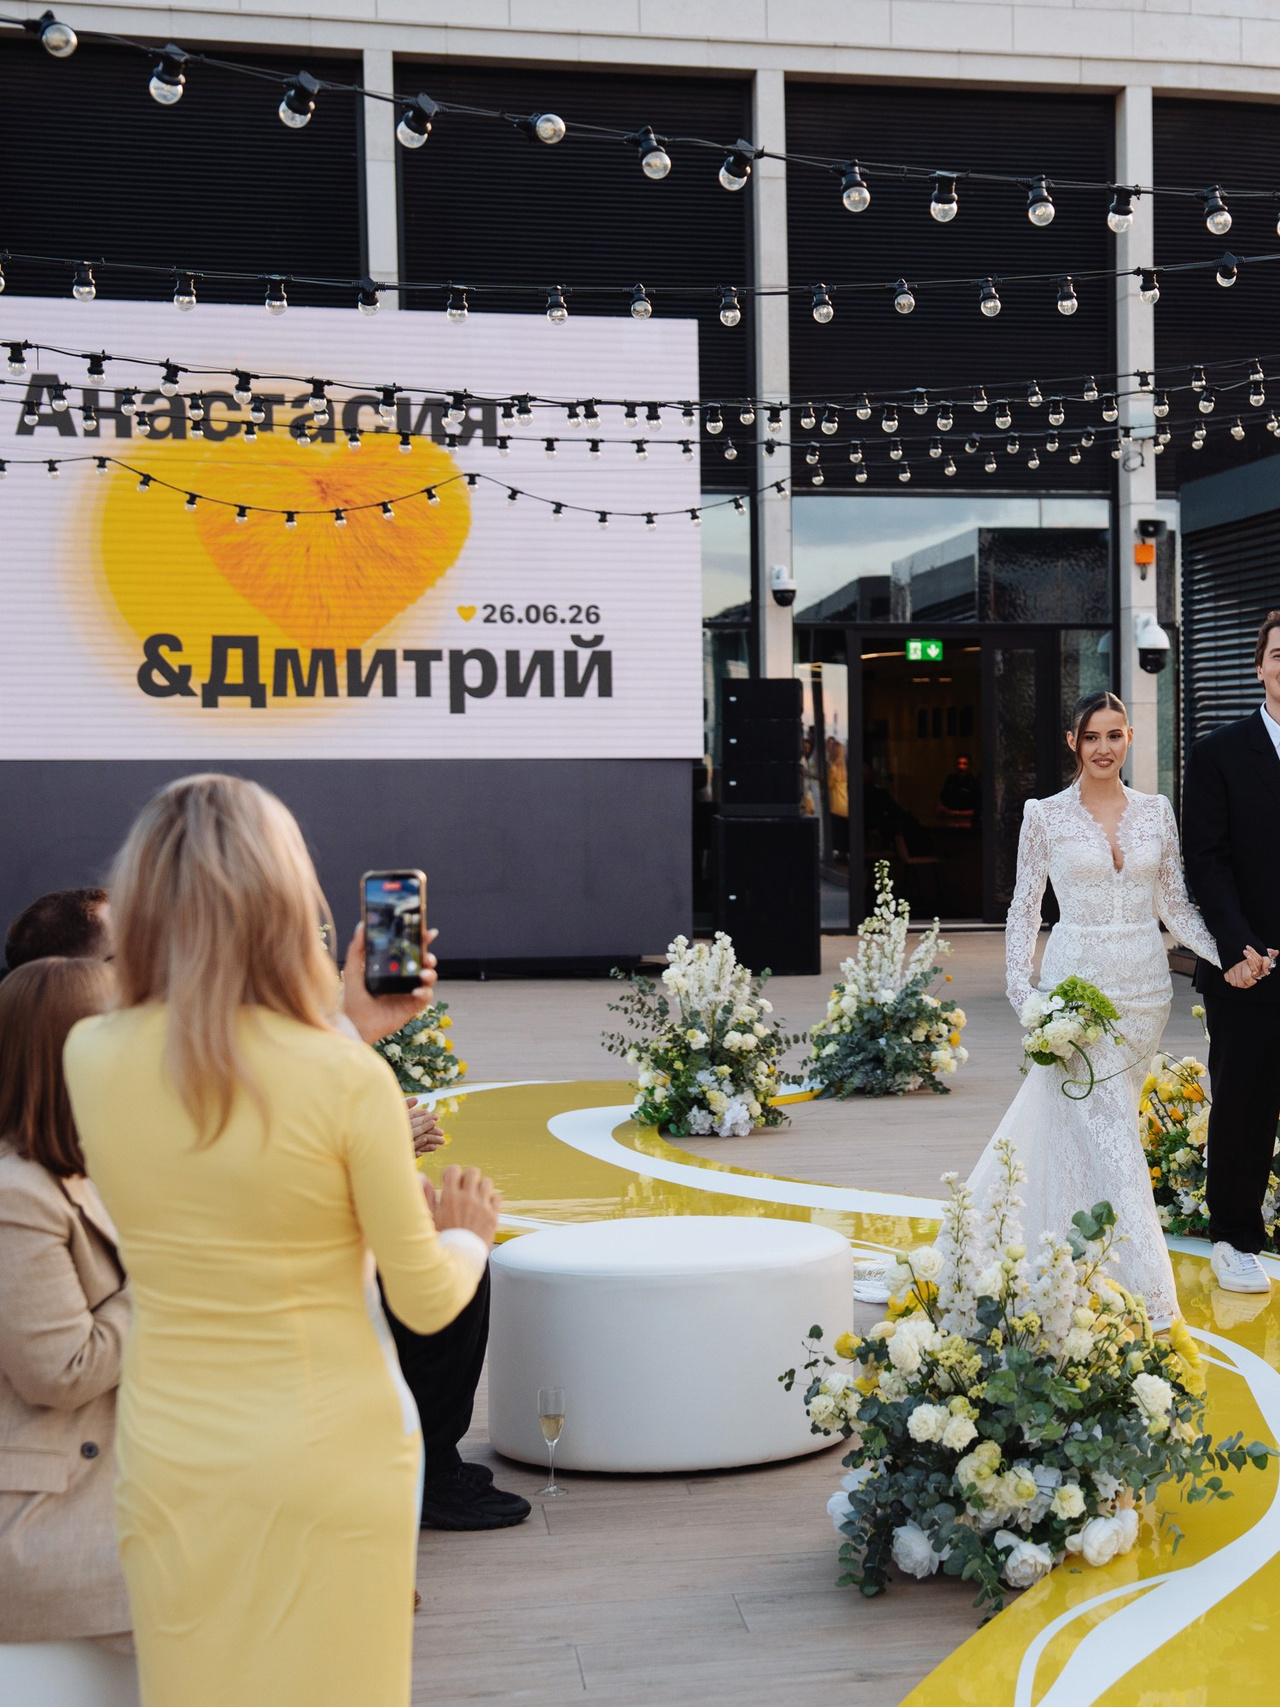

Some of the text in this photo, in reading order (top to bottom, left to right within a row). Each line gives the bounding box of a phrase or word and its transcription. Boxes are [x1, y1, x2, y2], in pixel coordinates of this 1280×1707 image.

[15, 373, 498, 446] Анастасия
[482, 604, 601, 624] 26.06.26
[137, 633, 613, 714] &Дмитрий
